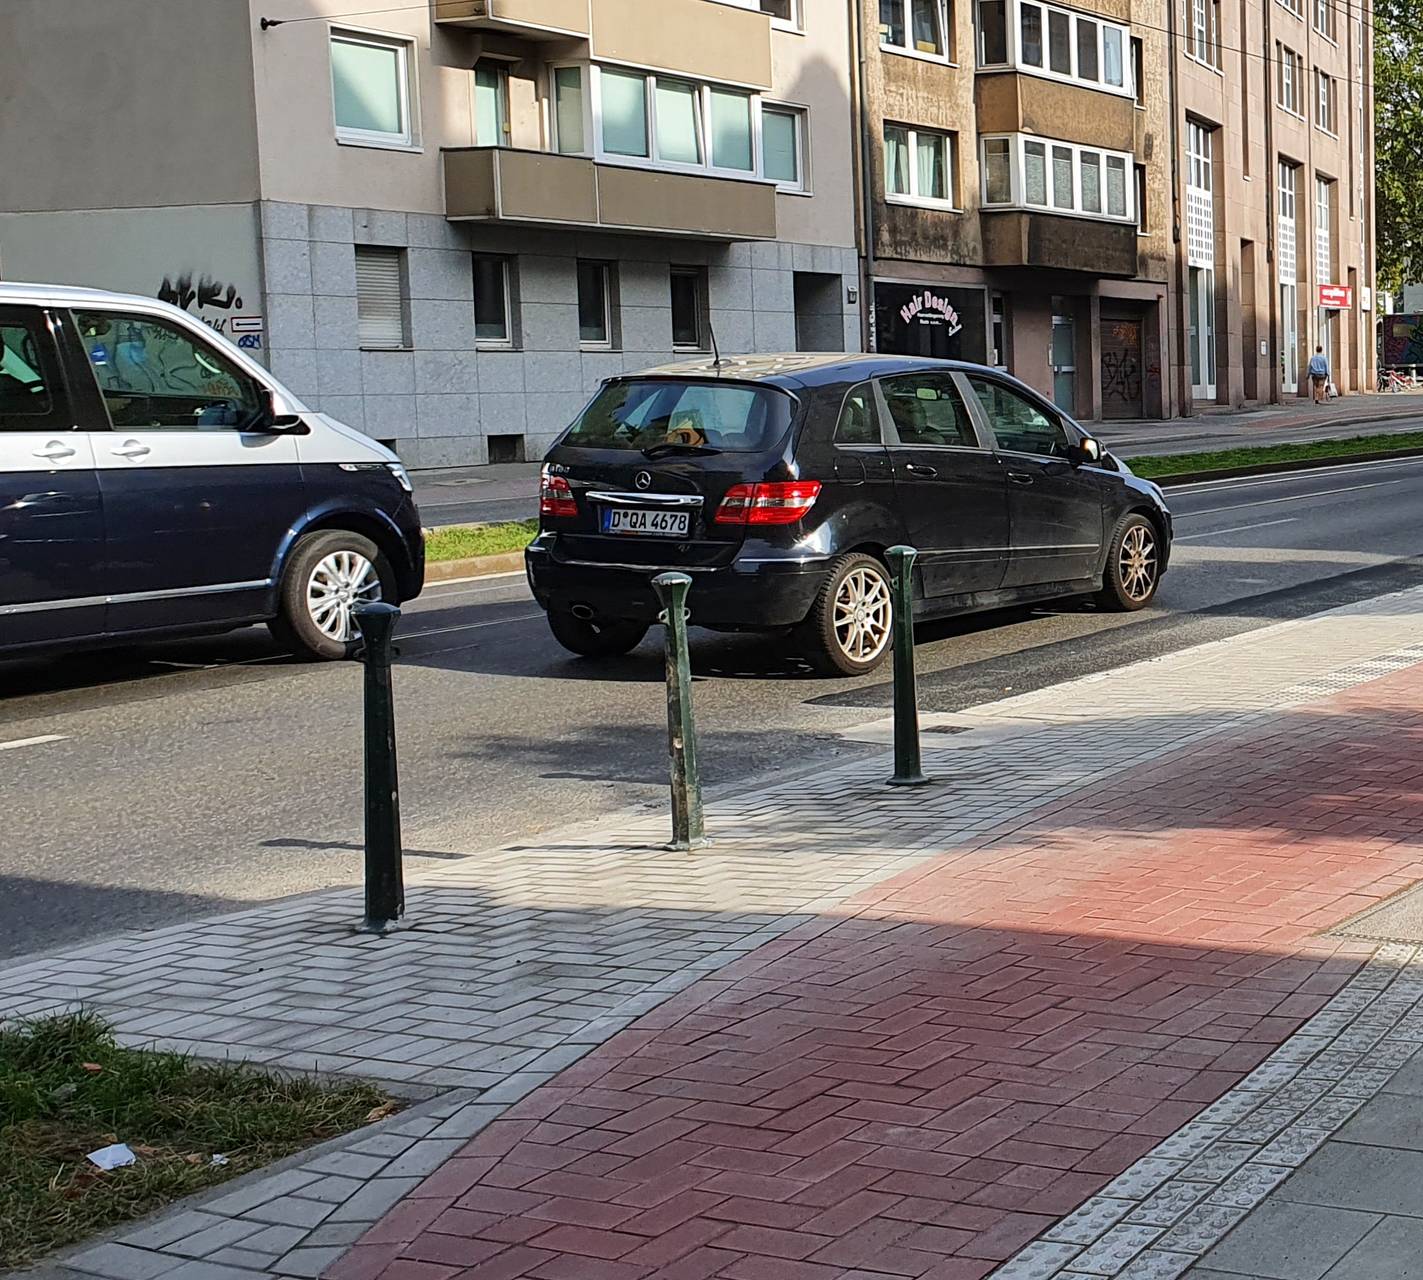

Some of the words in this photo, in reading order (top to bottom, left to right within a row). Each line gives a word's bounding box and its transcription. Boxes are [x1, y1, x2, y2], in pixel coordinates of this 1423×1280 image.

[900, 295, 923, 324] Hair
[611, 511, 621, 528] D
[629, 512, 647, 530] QA
[651, 513, 687, 531] 4678
